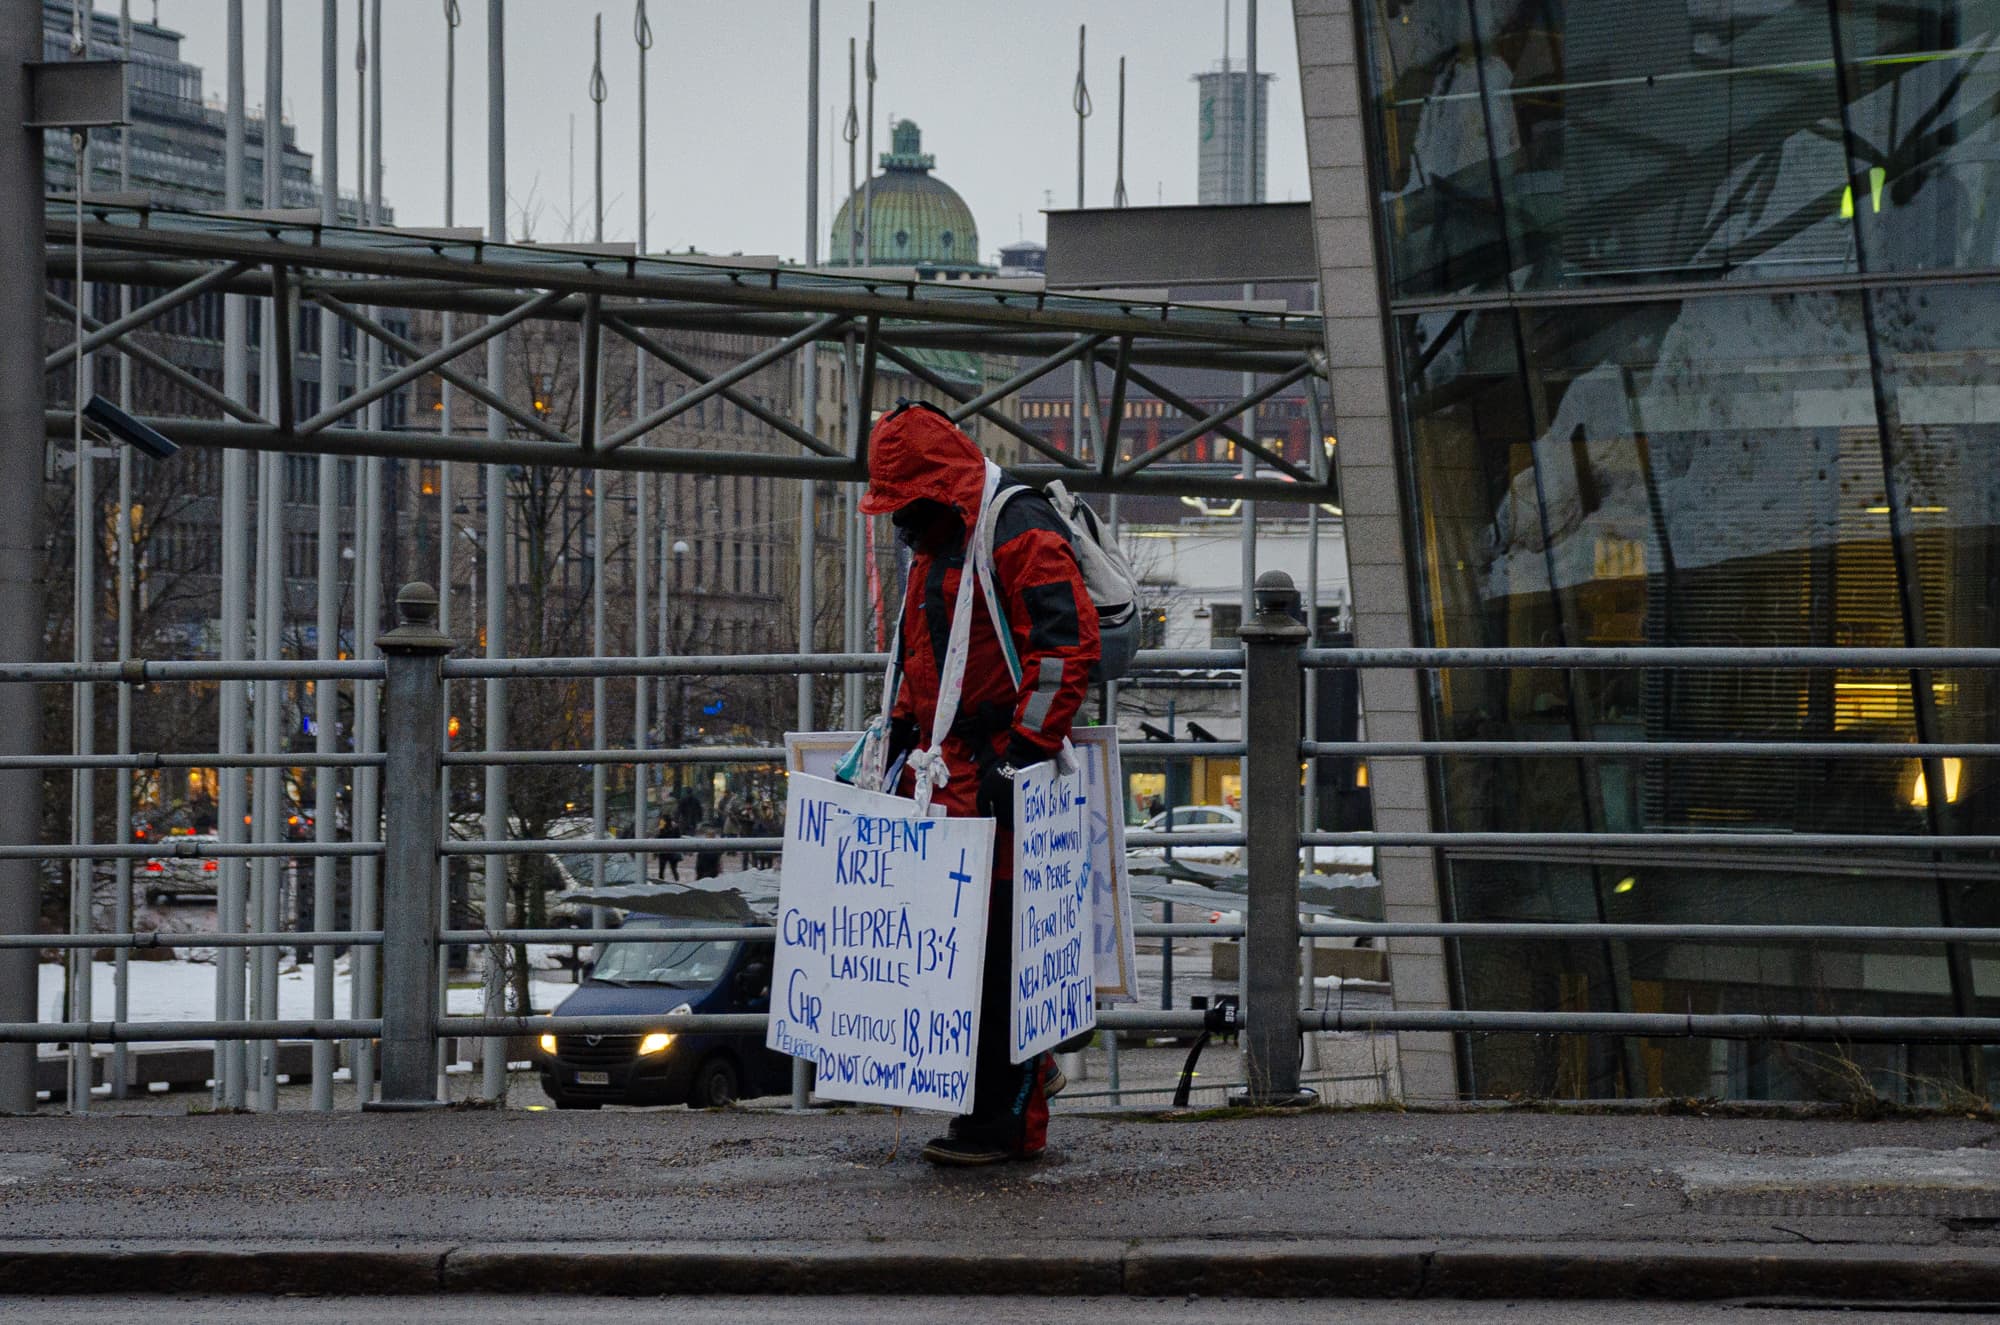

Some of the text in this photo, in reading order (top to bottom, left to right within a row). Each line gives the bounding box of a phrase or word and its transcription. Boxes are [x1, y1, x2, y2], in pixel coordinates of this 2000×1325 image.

[797, 798, 851, 847] INF
[856, 815, 936, 861] REPENT
[835, 836, 894, 888] KIRJE
[1045, 860, 1072, 893] PERHE
[831, 954, 910, 987] LAISILLE
[917, 926, 959, 980] 13:4
[1019, 930, 1082, 1003] NEW ADULTERY
[831, 1011, 896, 1045] LEVITICUS
[1018, 975, 1093, 1050] LAW ON EARTH
[862, 1056, 906, 1090] COMMIT
[908, 1067, 969, 1107] ADULTERY
